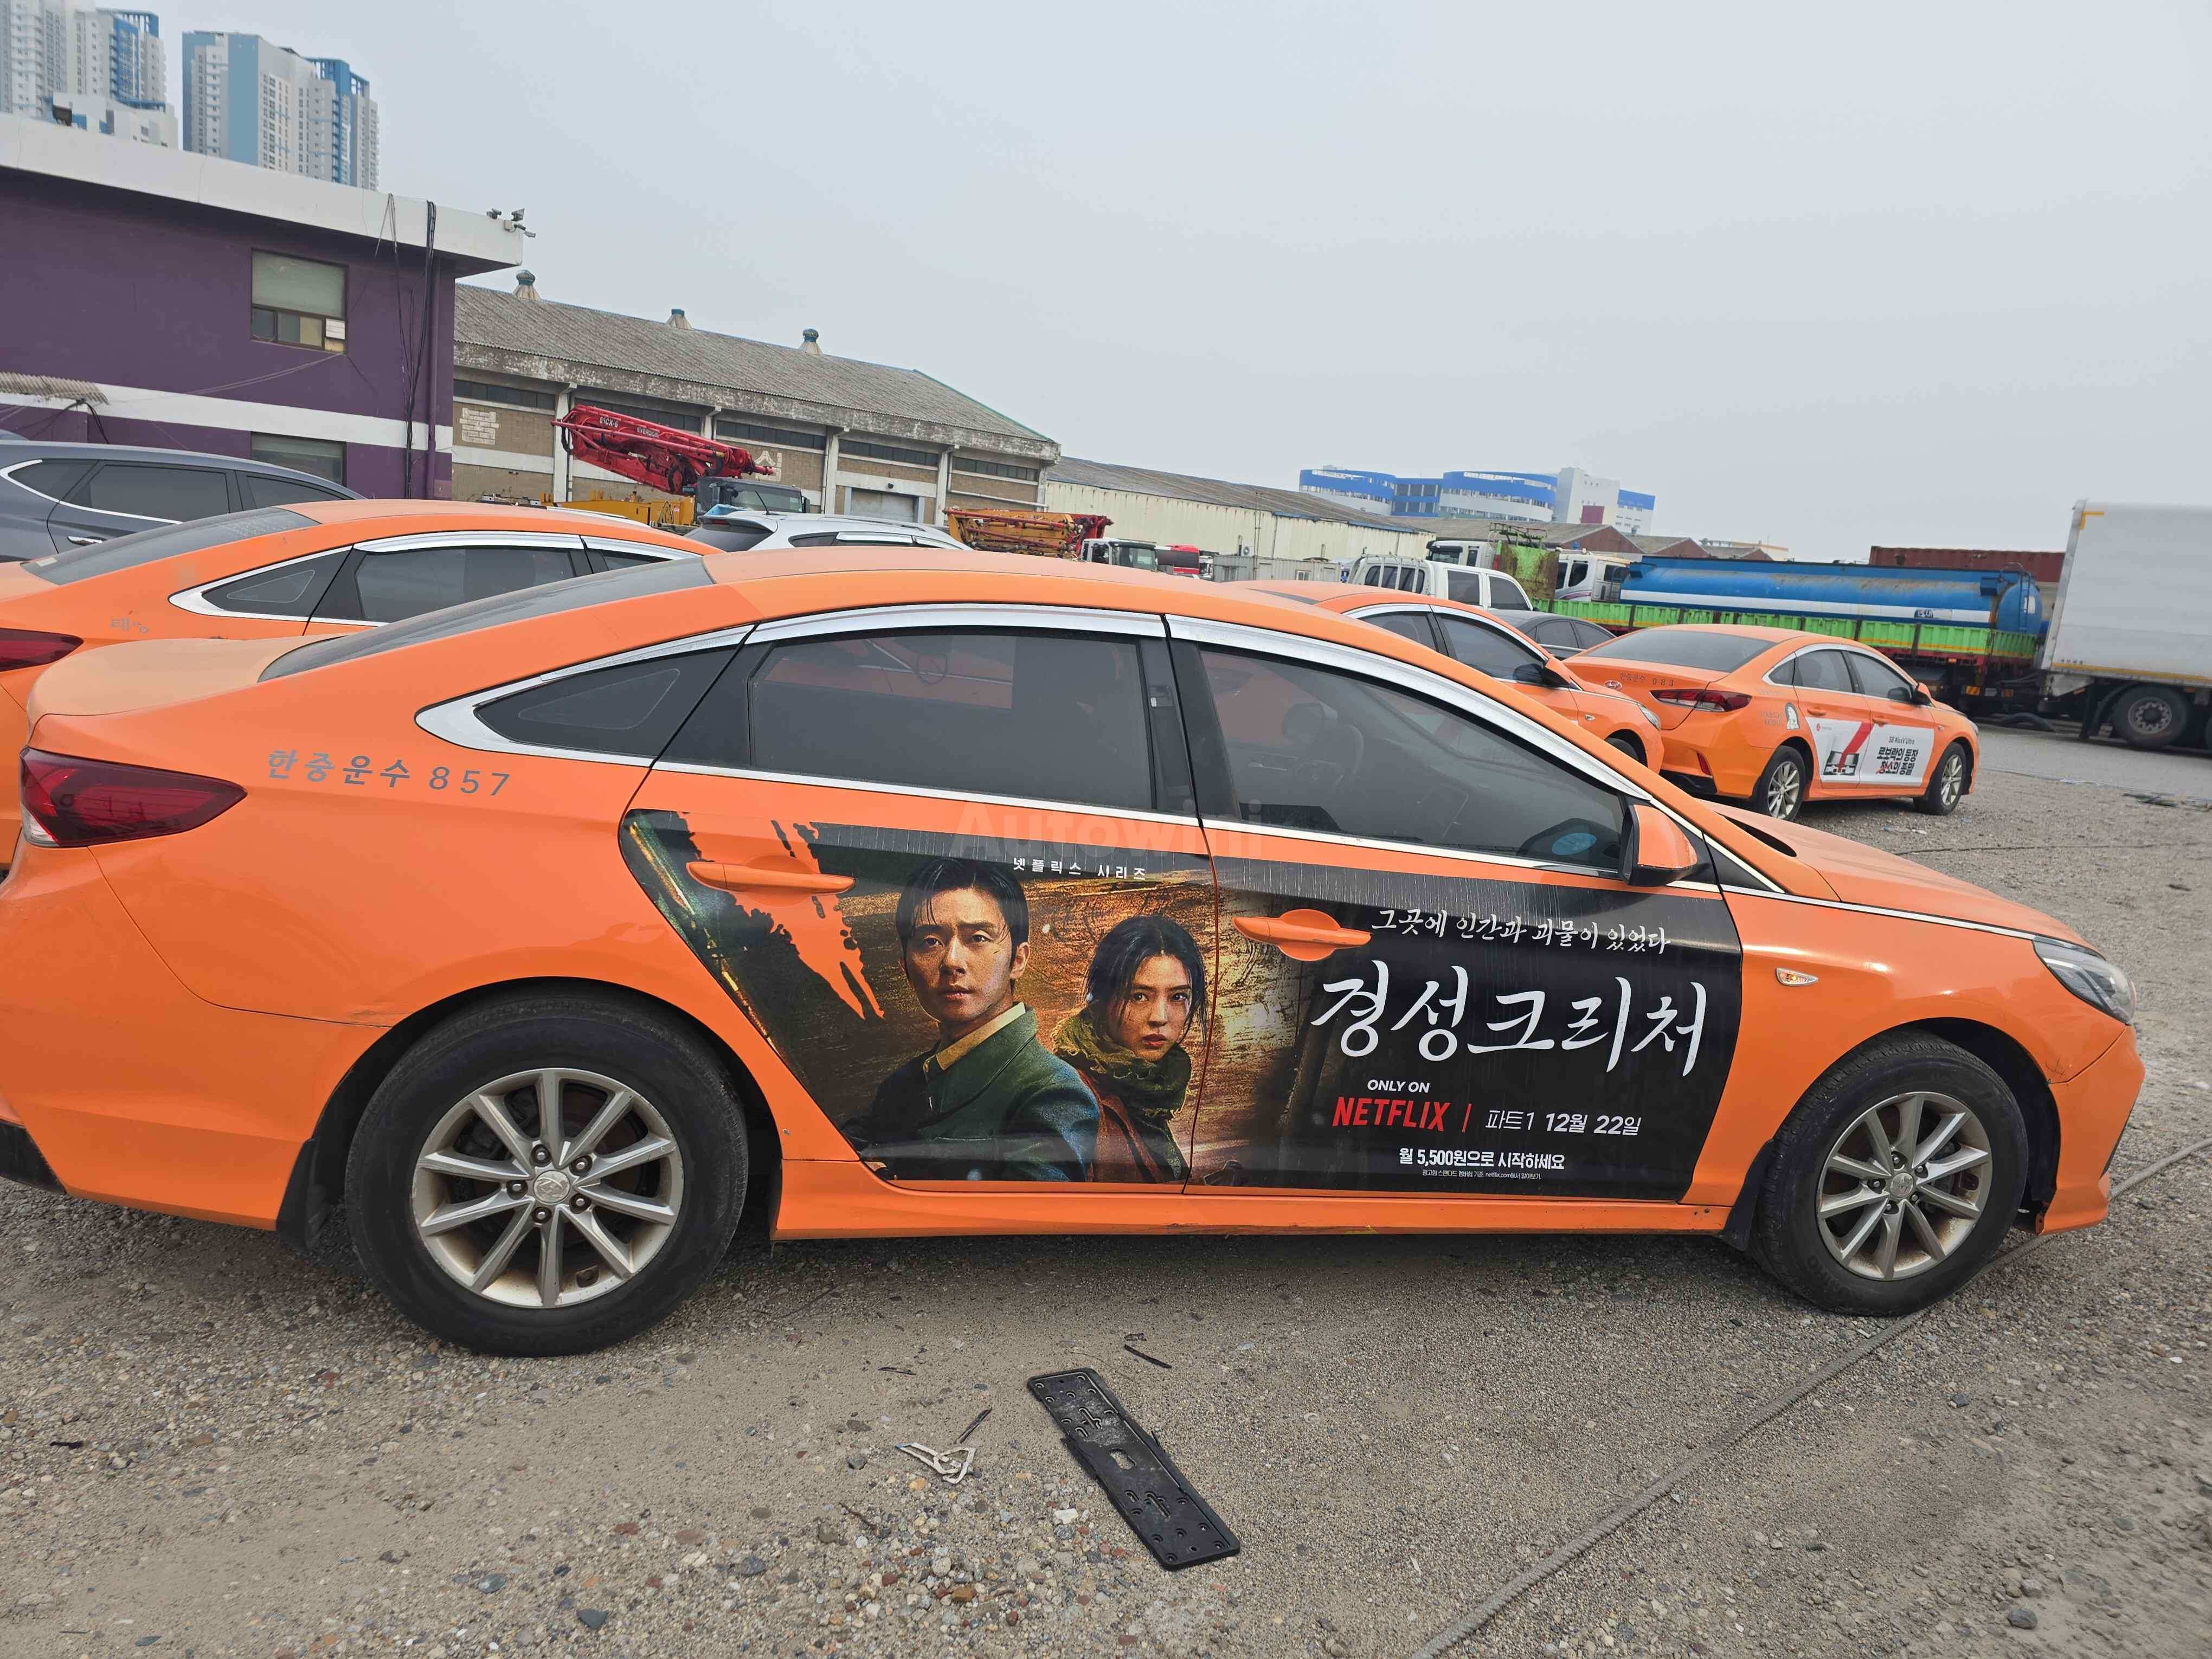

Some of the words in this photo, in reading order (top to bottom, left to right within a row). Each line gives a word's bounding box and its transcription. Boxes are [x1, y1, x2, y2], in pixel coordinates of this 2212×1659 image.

[268, 749, 410, 788] 한중운수
[429, 766, 510, 796] 857
[1013, 857, 1082, 876] 넷플릭스
[1097, 863, 1146, 880] 시리즈
[1372, 908, 1447, 937] 그곳에
[1456, 913, 1527, 943] 인간과
[1532, 919, 1599, 949] 괴물이
[1606, 924, 1671, 954] 있었다
[1311, 960, 1707, 1077] 경성크리처
[1367, 1079, 1406, 1092] ONLY
[1408, 1081, 1430, 1093] ON
[1332, 1096, 1451, 1132] NETFLIX
[1485, 1110, 1535, 1130] 파트1
[1545, 1113, 1588, 1134] 12월
[1593, 1115, 1642, 1136] 22일
[1399, 1148, 1413, 1165] 월
[1417, 1149, 1494, 1167] 5,500원으로
[1498, 1152, 1565, 1170] 시작하세요
